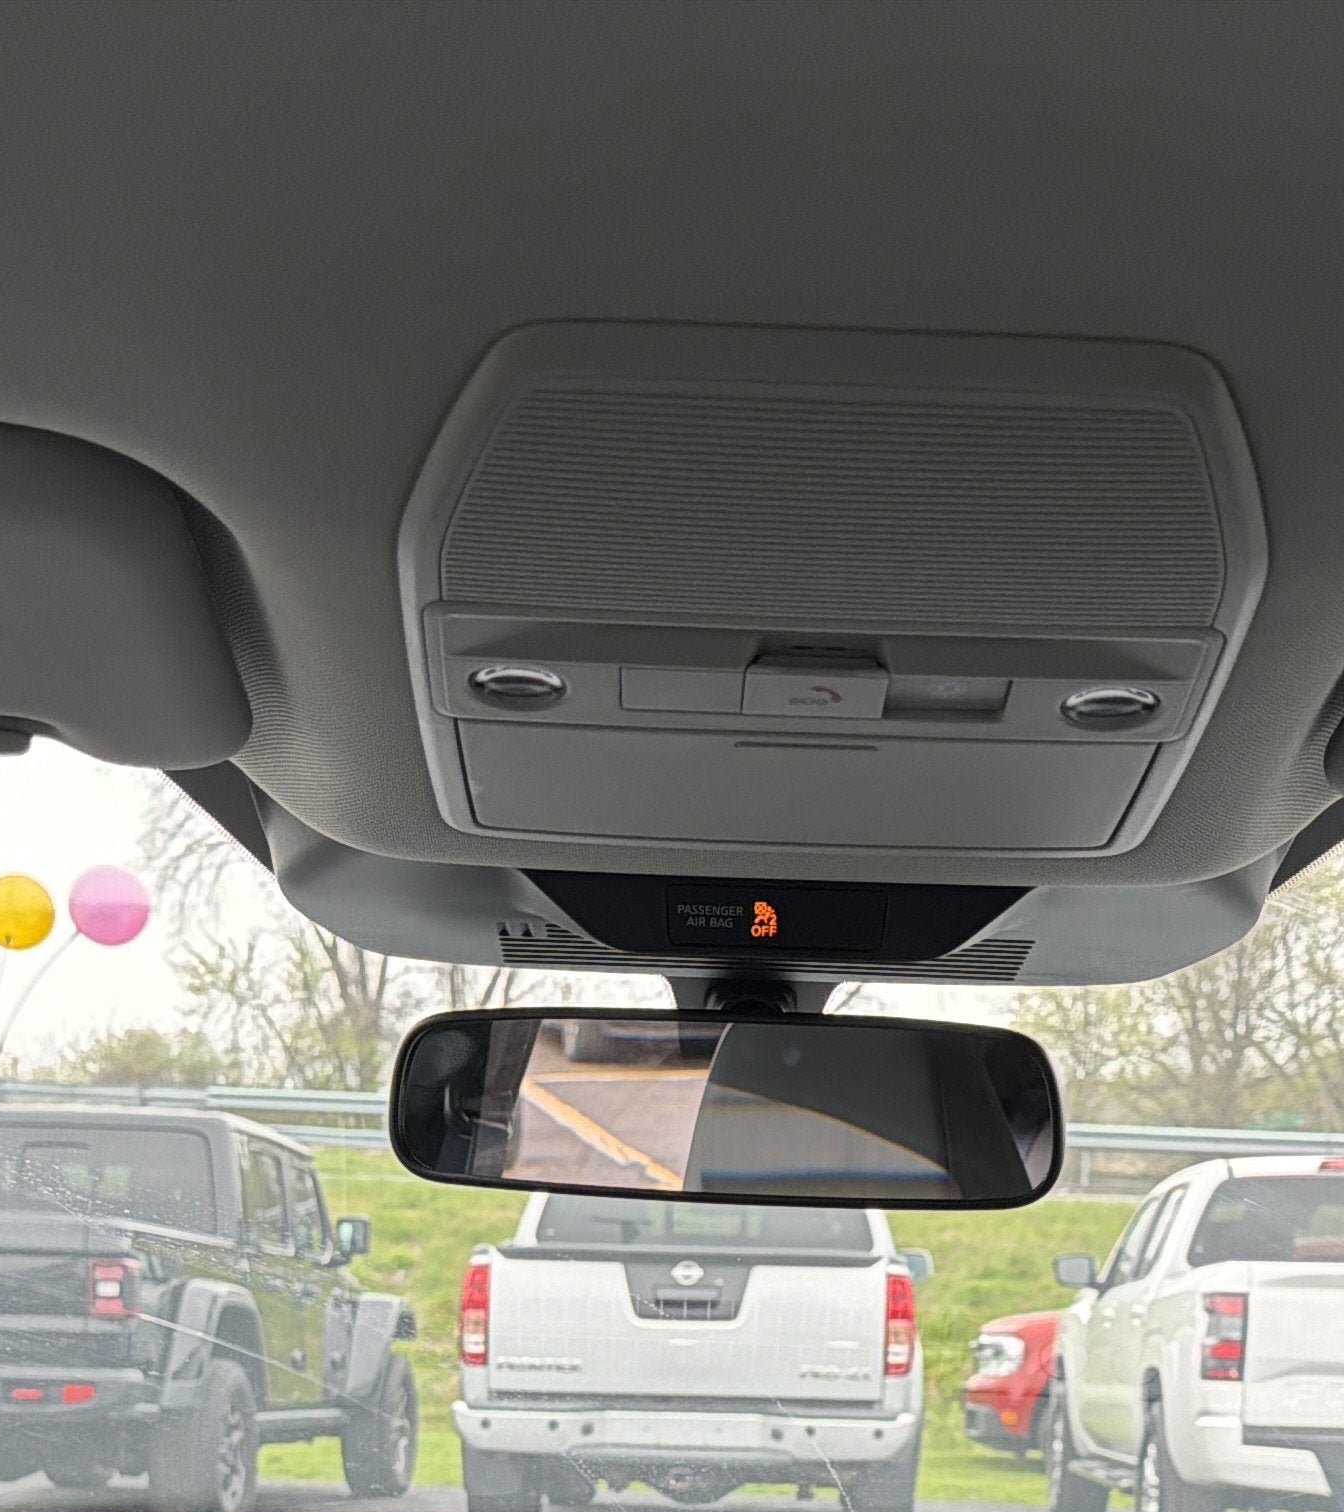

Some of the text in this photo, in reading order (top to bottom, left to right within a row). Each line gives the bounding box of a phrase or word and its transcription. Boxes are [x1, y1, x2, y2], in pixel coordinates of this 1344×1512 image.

[677, 904, 744, 917] PASSENGER
[686, 916, 734, 929] AIR BAG
[750, 925, 777, 937] OFF
